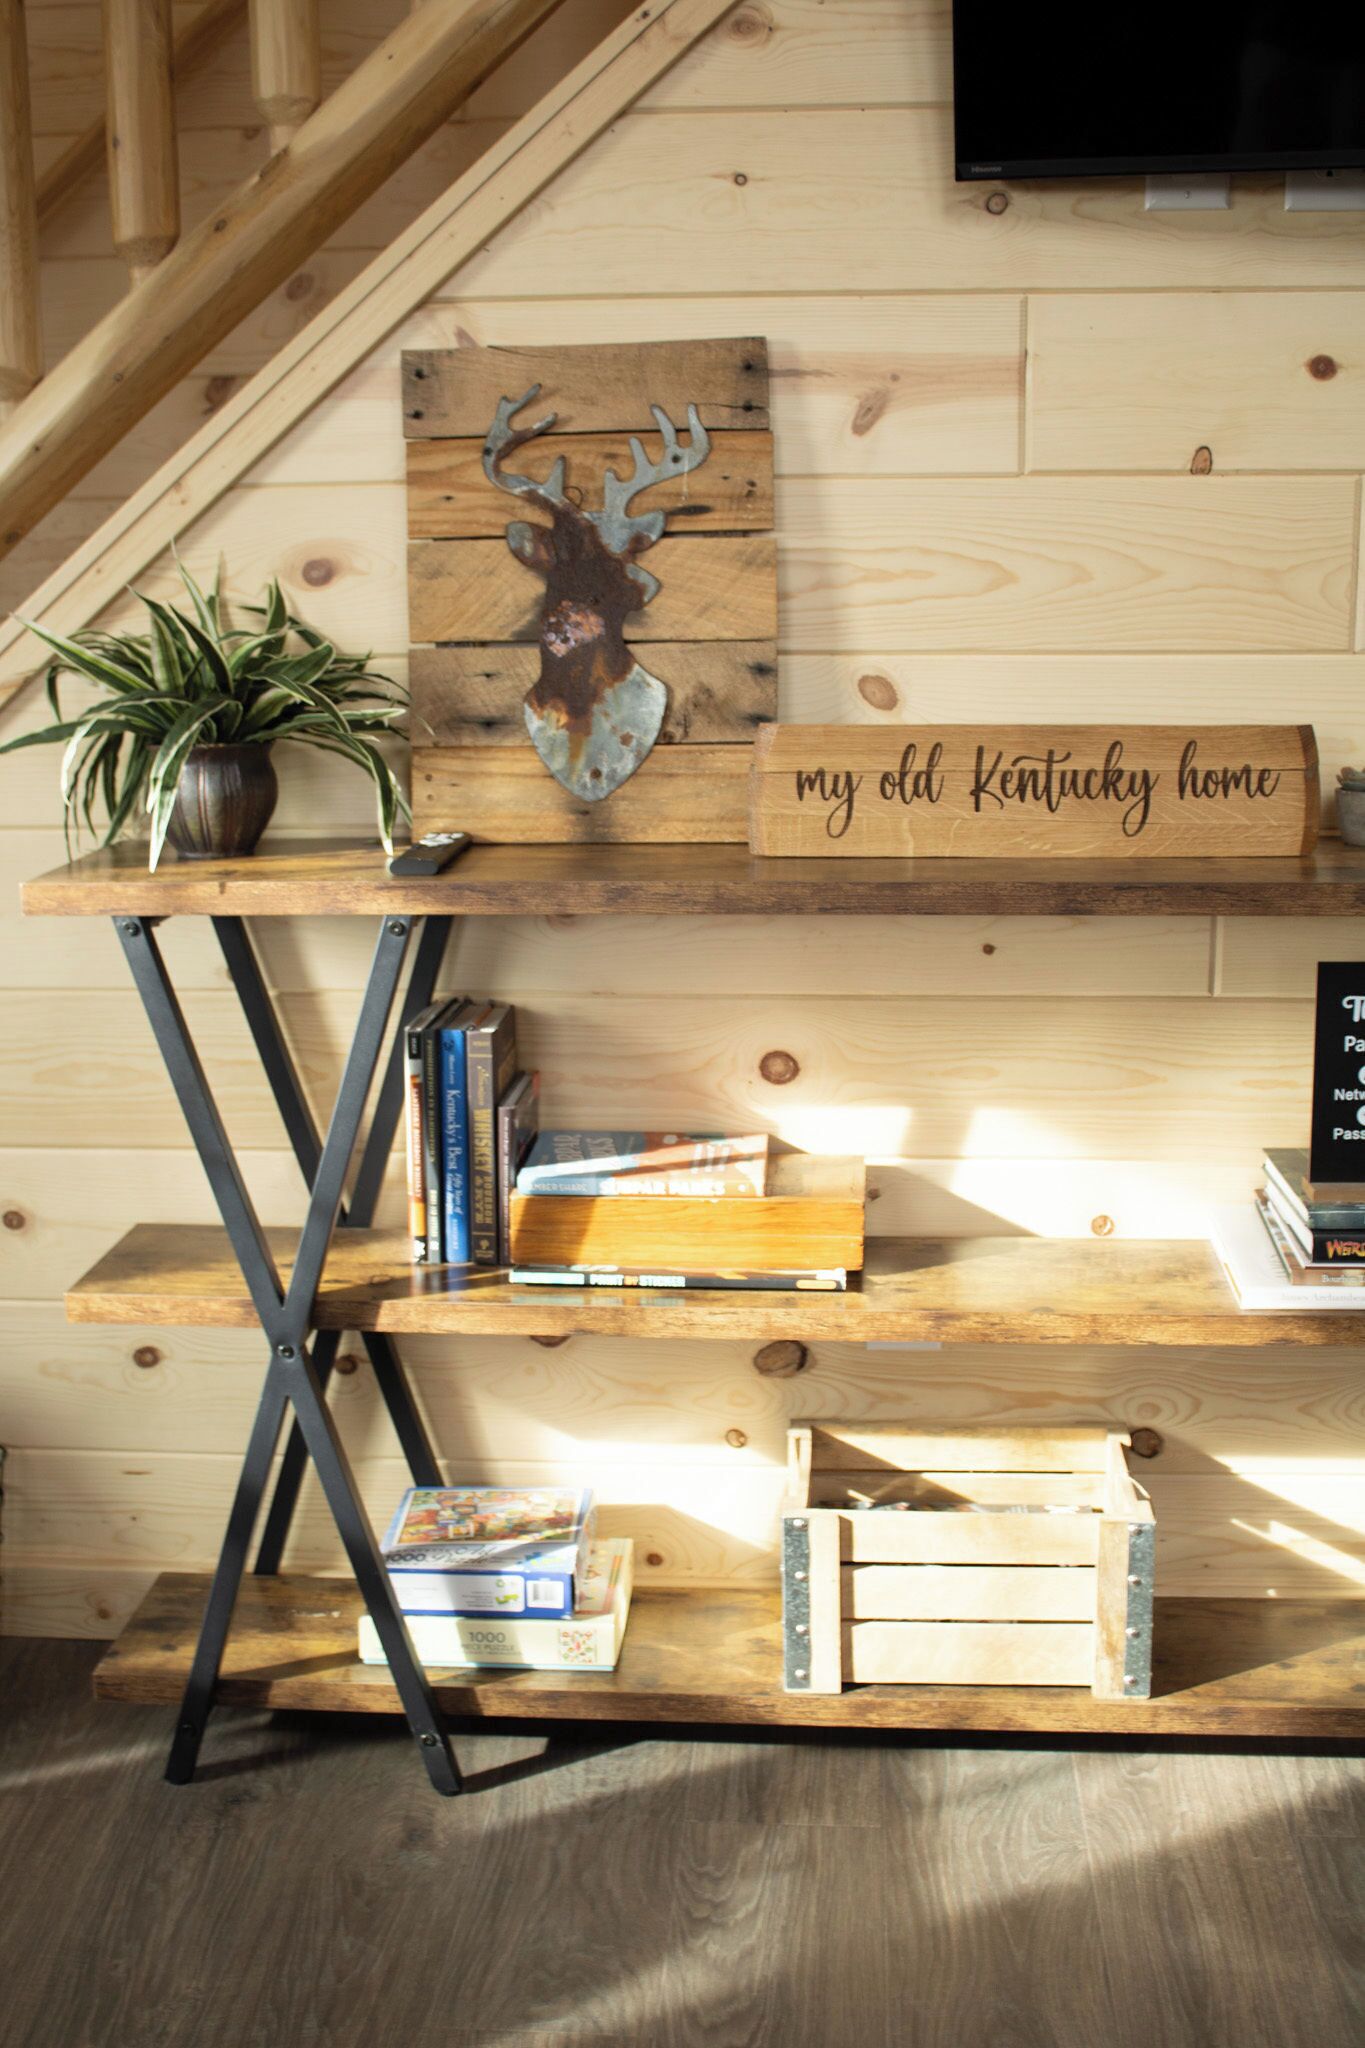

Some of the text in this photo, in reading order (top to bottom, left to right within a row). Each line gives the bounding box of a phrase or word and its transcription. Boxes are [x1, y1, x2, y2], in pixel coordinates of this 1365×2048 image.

[796, 740, 1281, 838] my old Kentucky home
[445, 1090, 463, 1169] Kentucky's Best
[473, 1109, 494, 1174] WHISKEY
[468, 1632, 506, 1643] 1000
